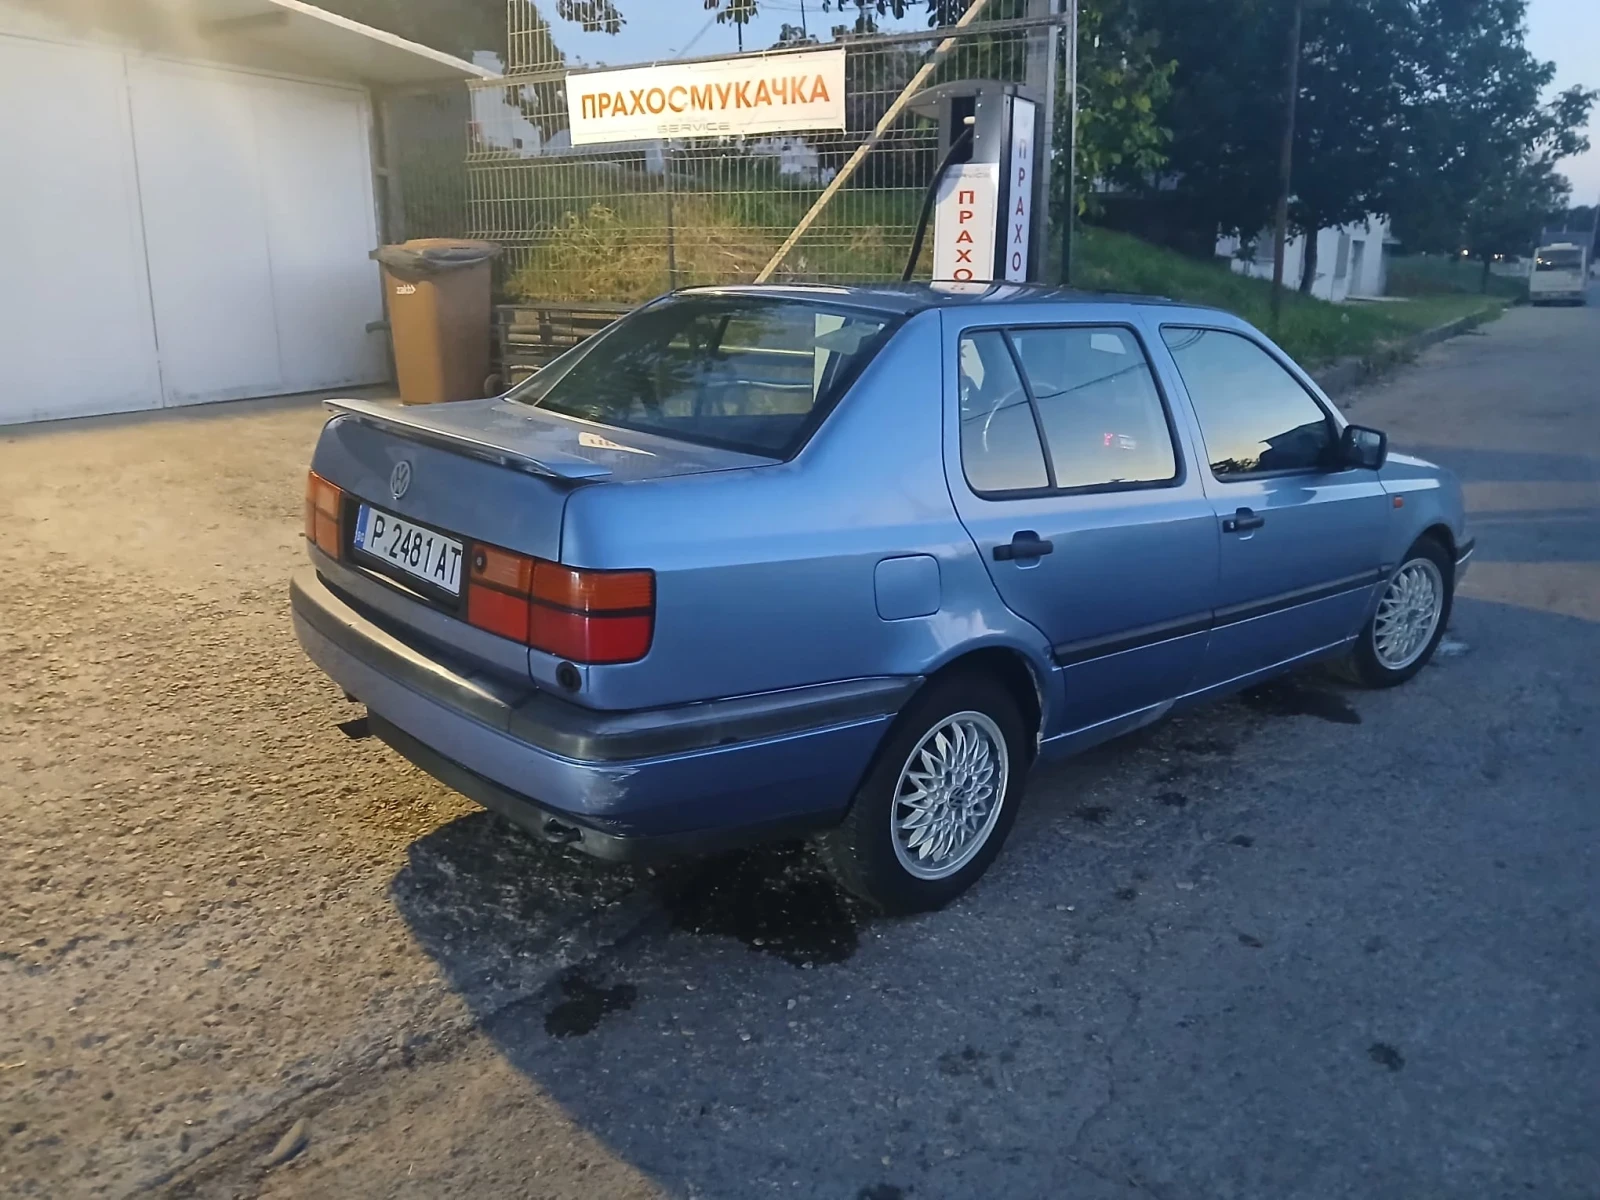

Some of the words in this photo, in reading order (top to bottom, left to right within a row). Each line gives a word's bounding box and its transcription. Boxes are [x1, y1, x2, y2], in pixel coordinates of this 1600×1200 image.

[581, 74, 830, 119] ПРАХОСМУКАЧКА
[656, 122, 730, 134] SERVICE
[953, 190, 975, 281] ПРАХО
[1012, 140, 1027, 273] ПРАХО
